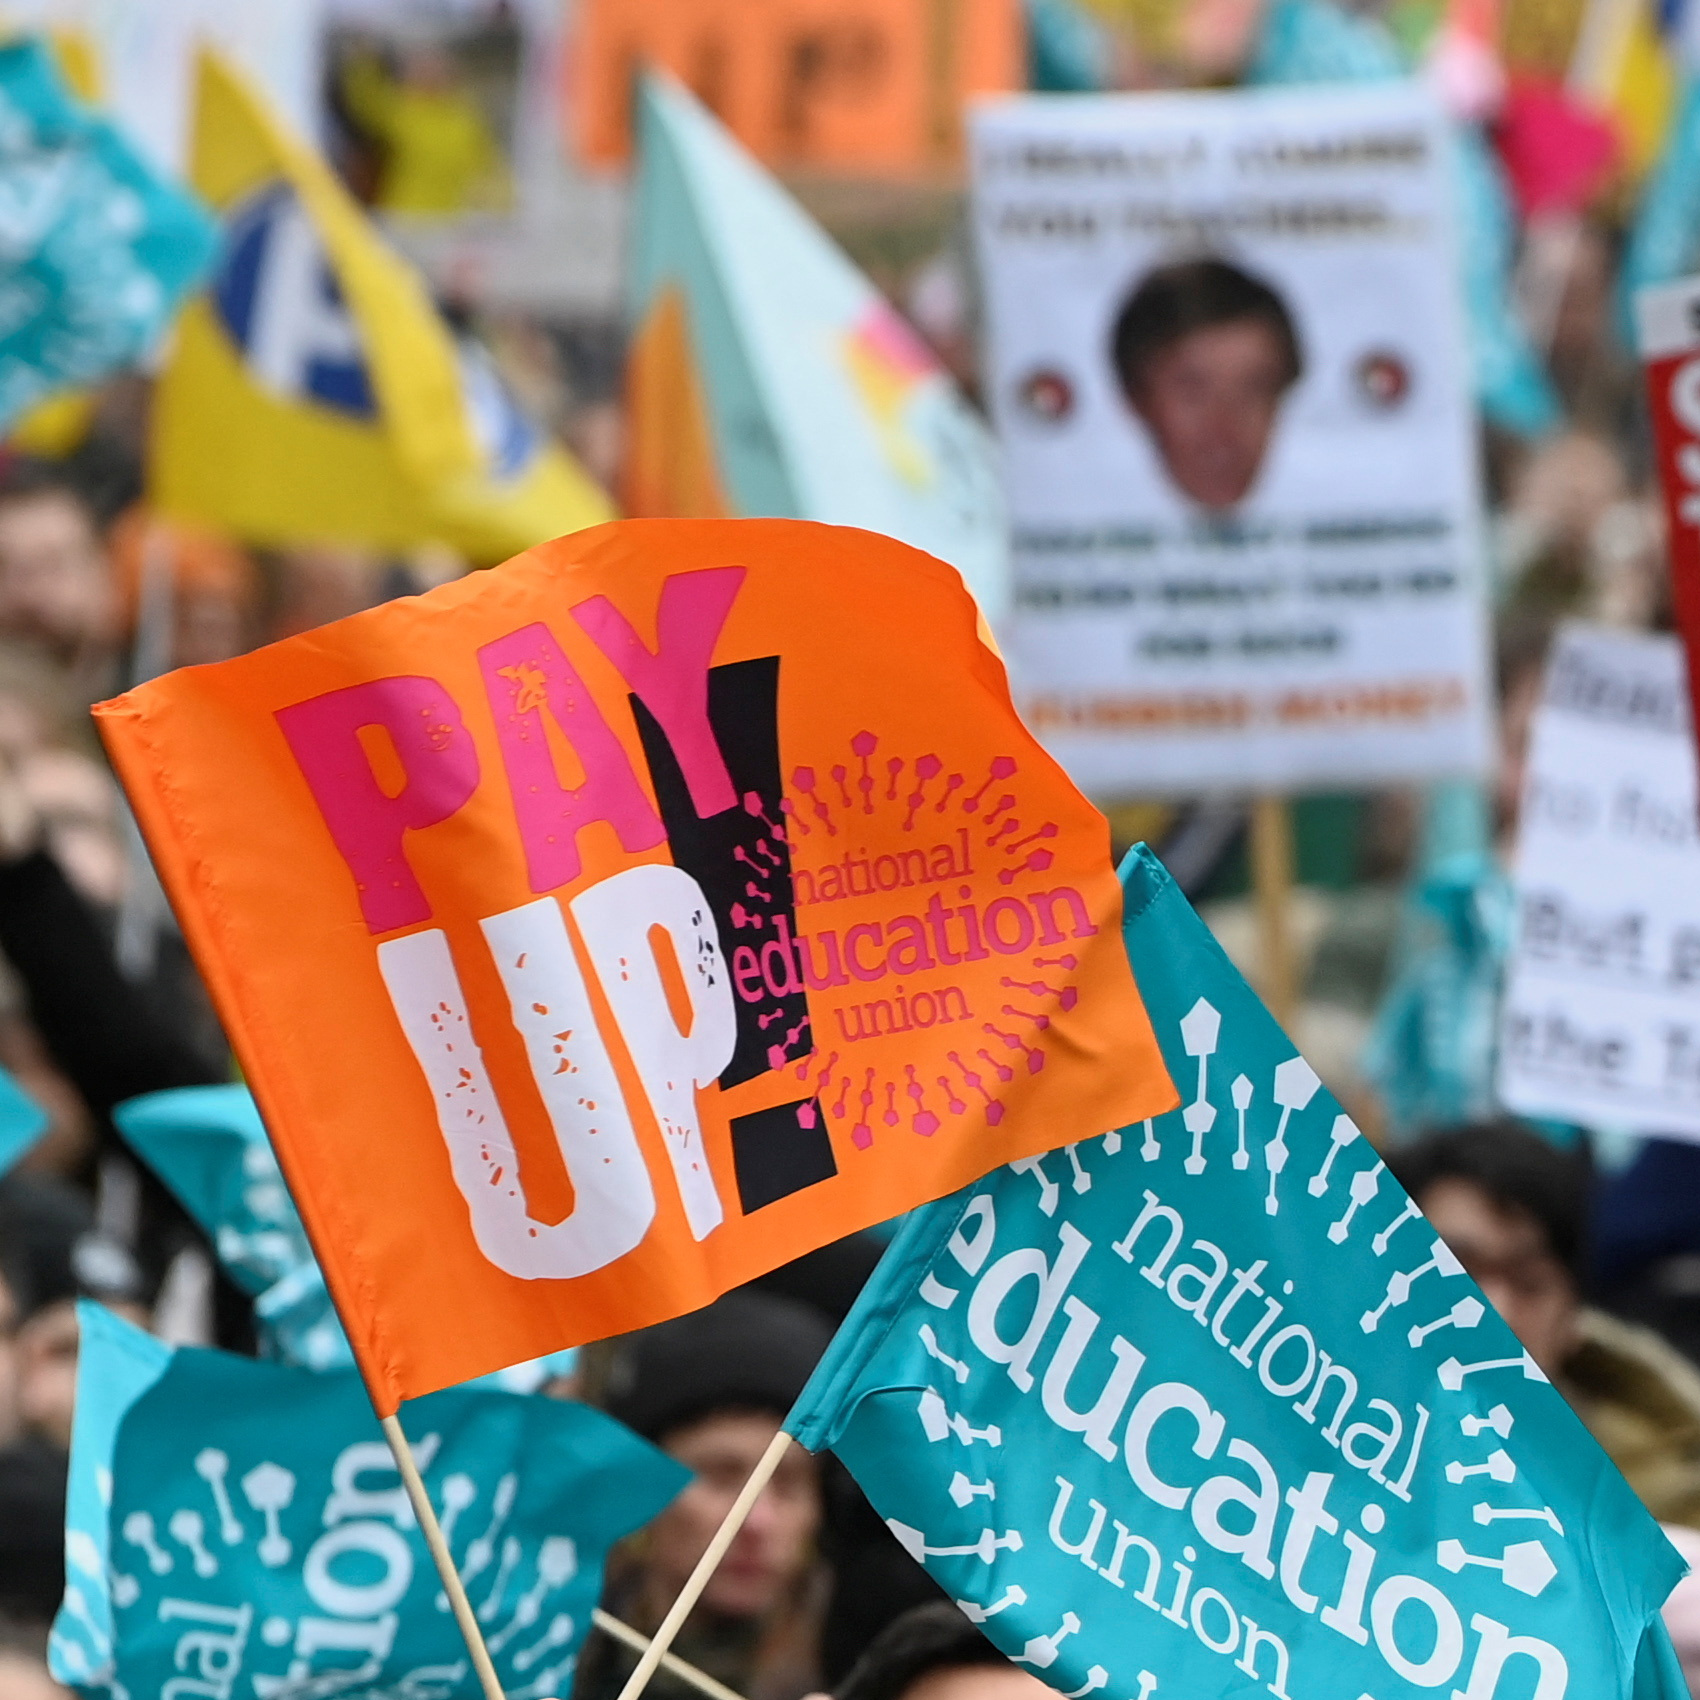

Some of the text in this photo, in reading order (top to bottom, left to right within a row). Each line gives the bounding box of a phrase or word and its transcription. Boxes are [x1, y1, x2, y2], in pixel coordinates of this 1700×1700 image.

[274, 566, 748, 934] PAY
[790, 830, 974, 908] national
[733, 884, 1098, 1004] education
[834, 984, 974, 1044] union
[1112, 1190, 1427, 1504] national
